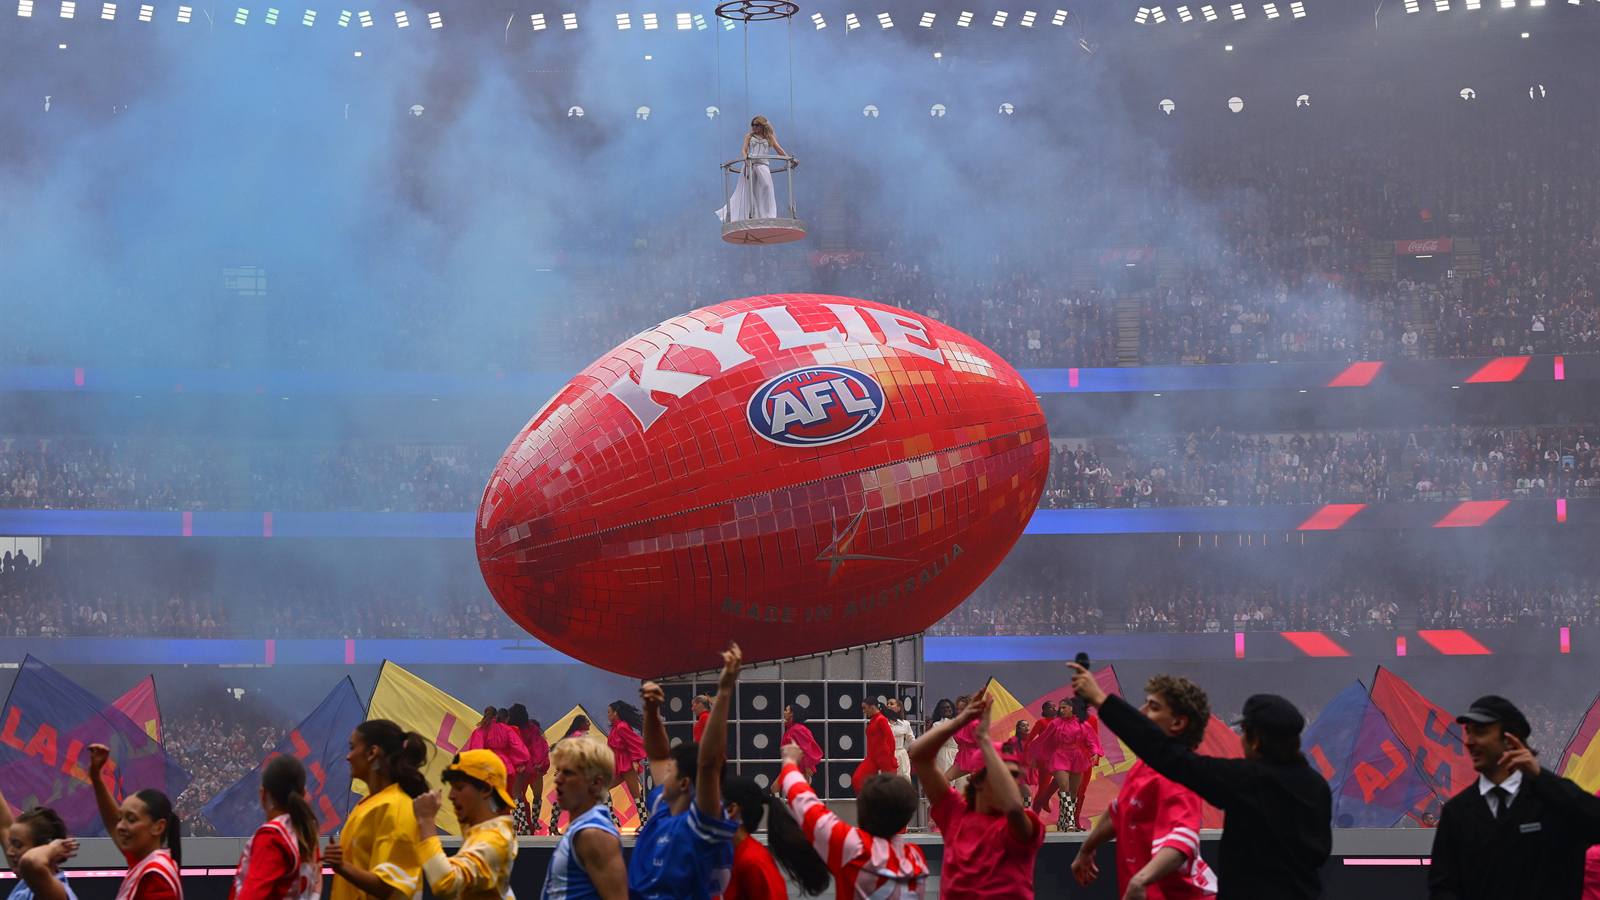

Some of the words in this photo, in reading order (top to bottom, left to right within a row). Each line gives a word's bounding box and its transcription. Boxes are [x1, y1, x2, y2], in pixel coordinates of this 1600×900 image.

[607, 303, 944, 433] KYLIE
[769, 377, 877, 435] AFL
[720, 596, 795, 624] MADE
[804, 604, 833, 622] IN
[843, 543, 965, 619] AUSTRALIA
